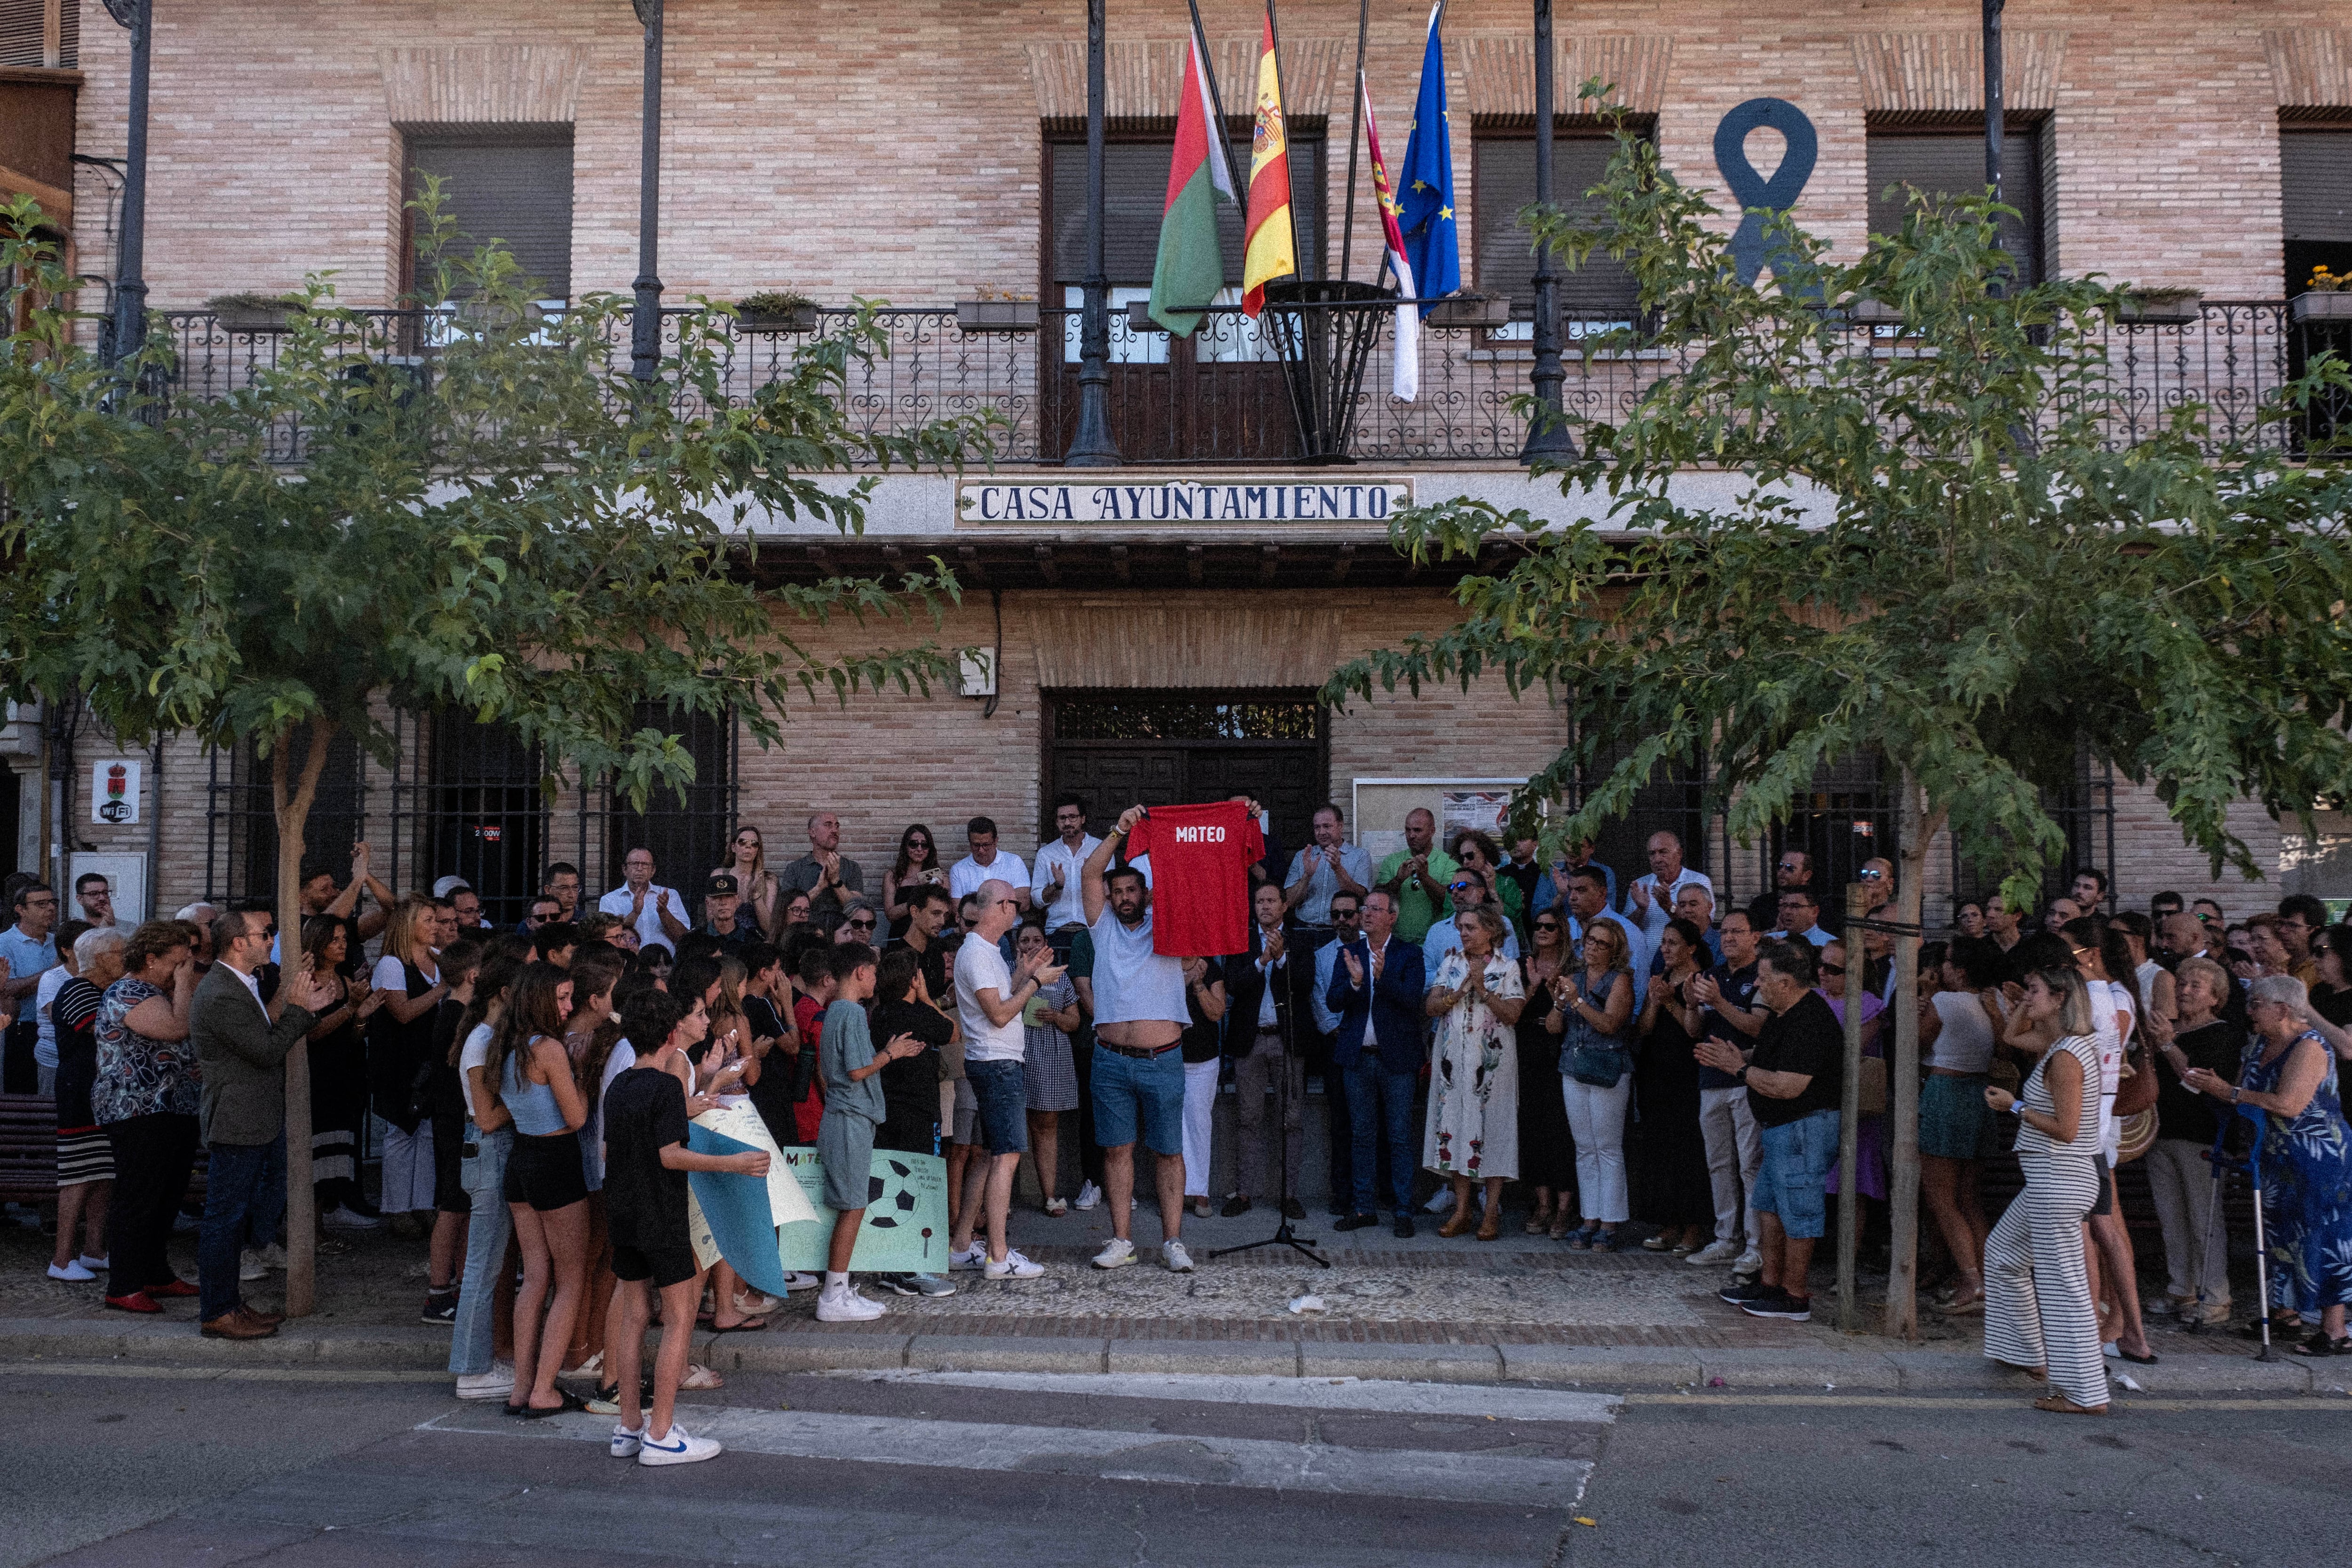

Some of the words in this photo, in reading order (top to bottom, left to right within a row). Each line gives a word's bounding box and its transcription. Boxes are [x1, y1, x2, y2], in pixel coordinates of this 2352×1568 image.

[981, 487, 1074, 520] CASA
[1093, 486, 1388, 520] AYUNTAMIENTO
[1176, 826, 1225, 842] MATEO
